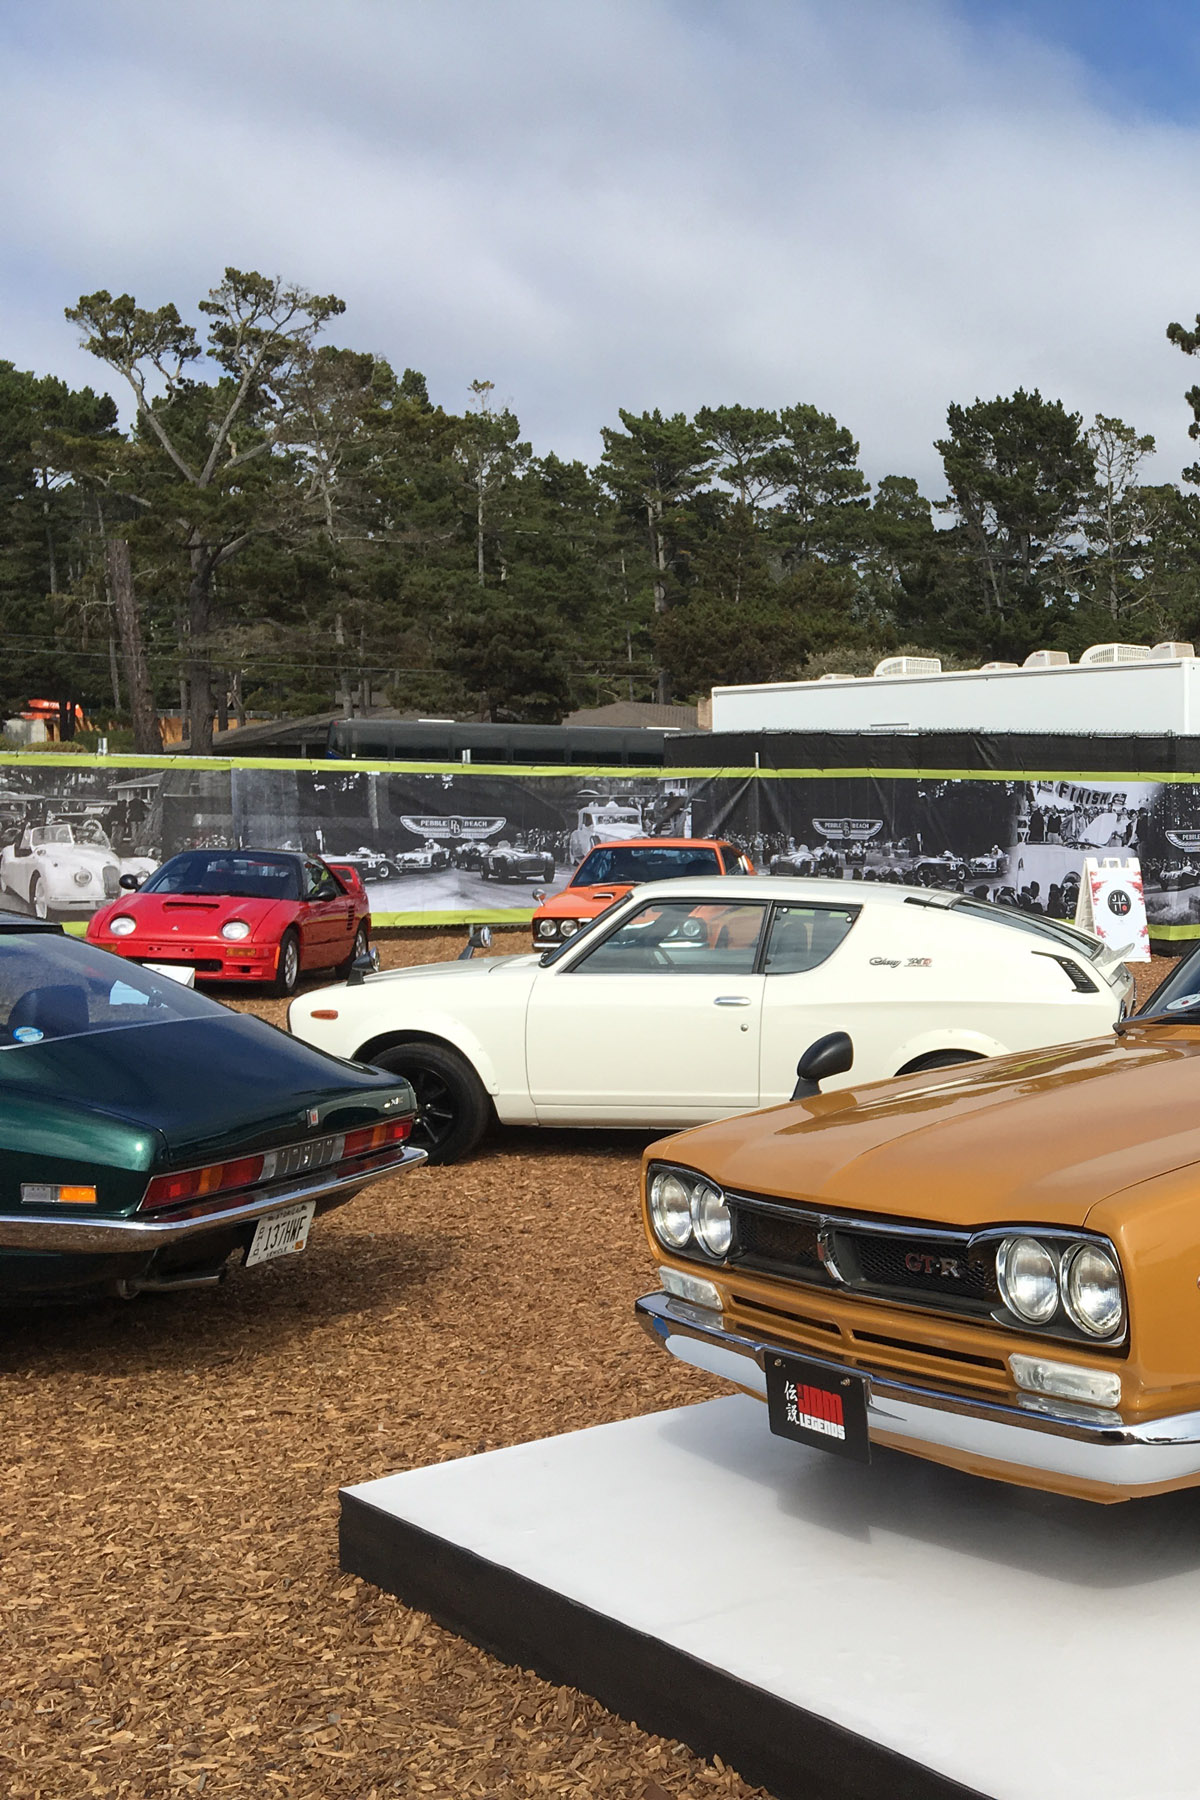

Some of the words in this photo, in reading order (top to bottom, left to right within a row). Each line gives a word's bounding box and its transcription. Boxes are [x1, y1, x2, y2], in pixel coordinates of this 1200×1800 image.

[1058, 782, 1110, 805] FINISH
[420, 819, 447, 827] PEBBLE
[799, 1412, 847, 1441] LEGENDS
